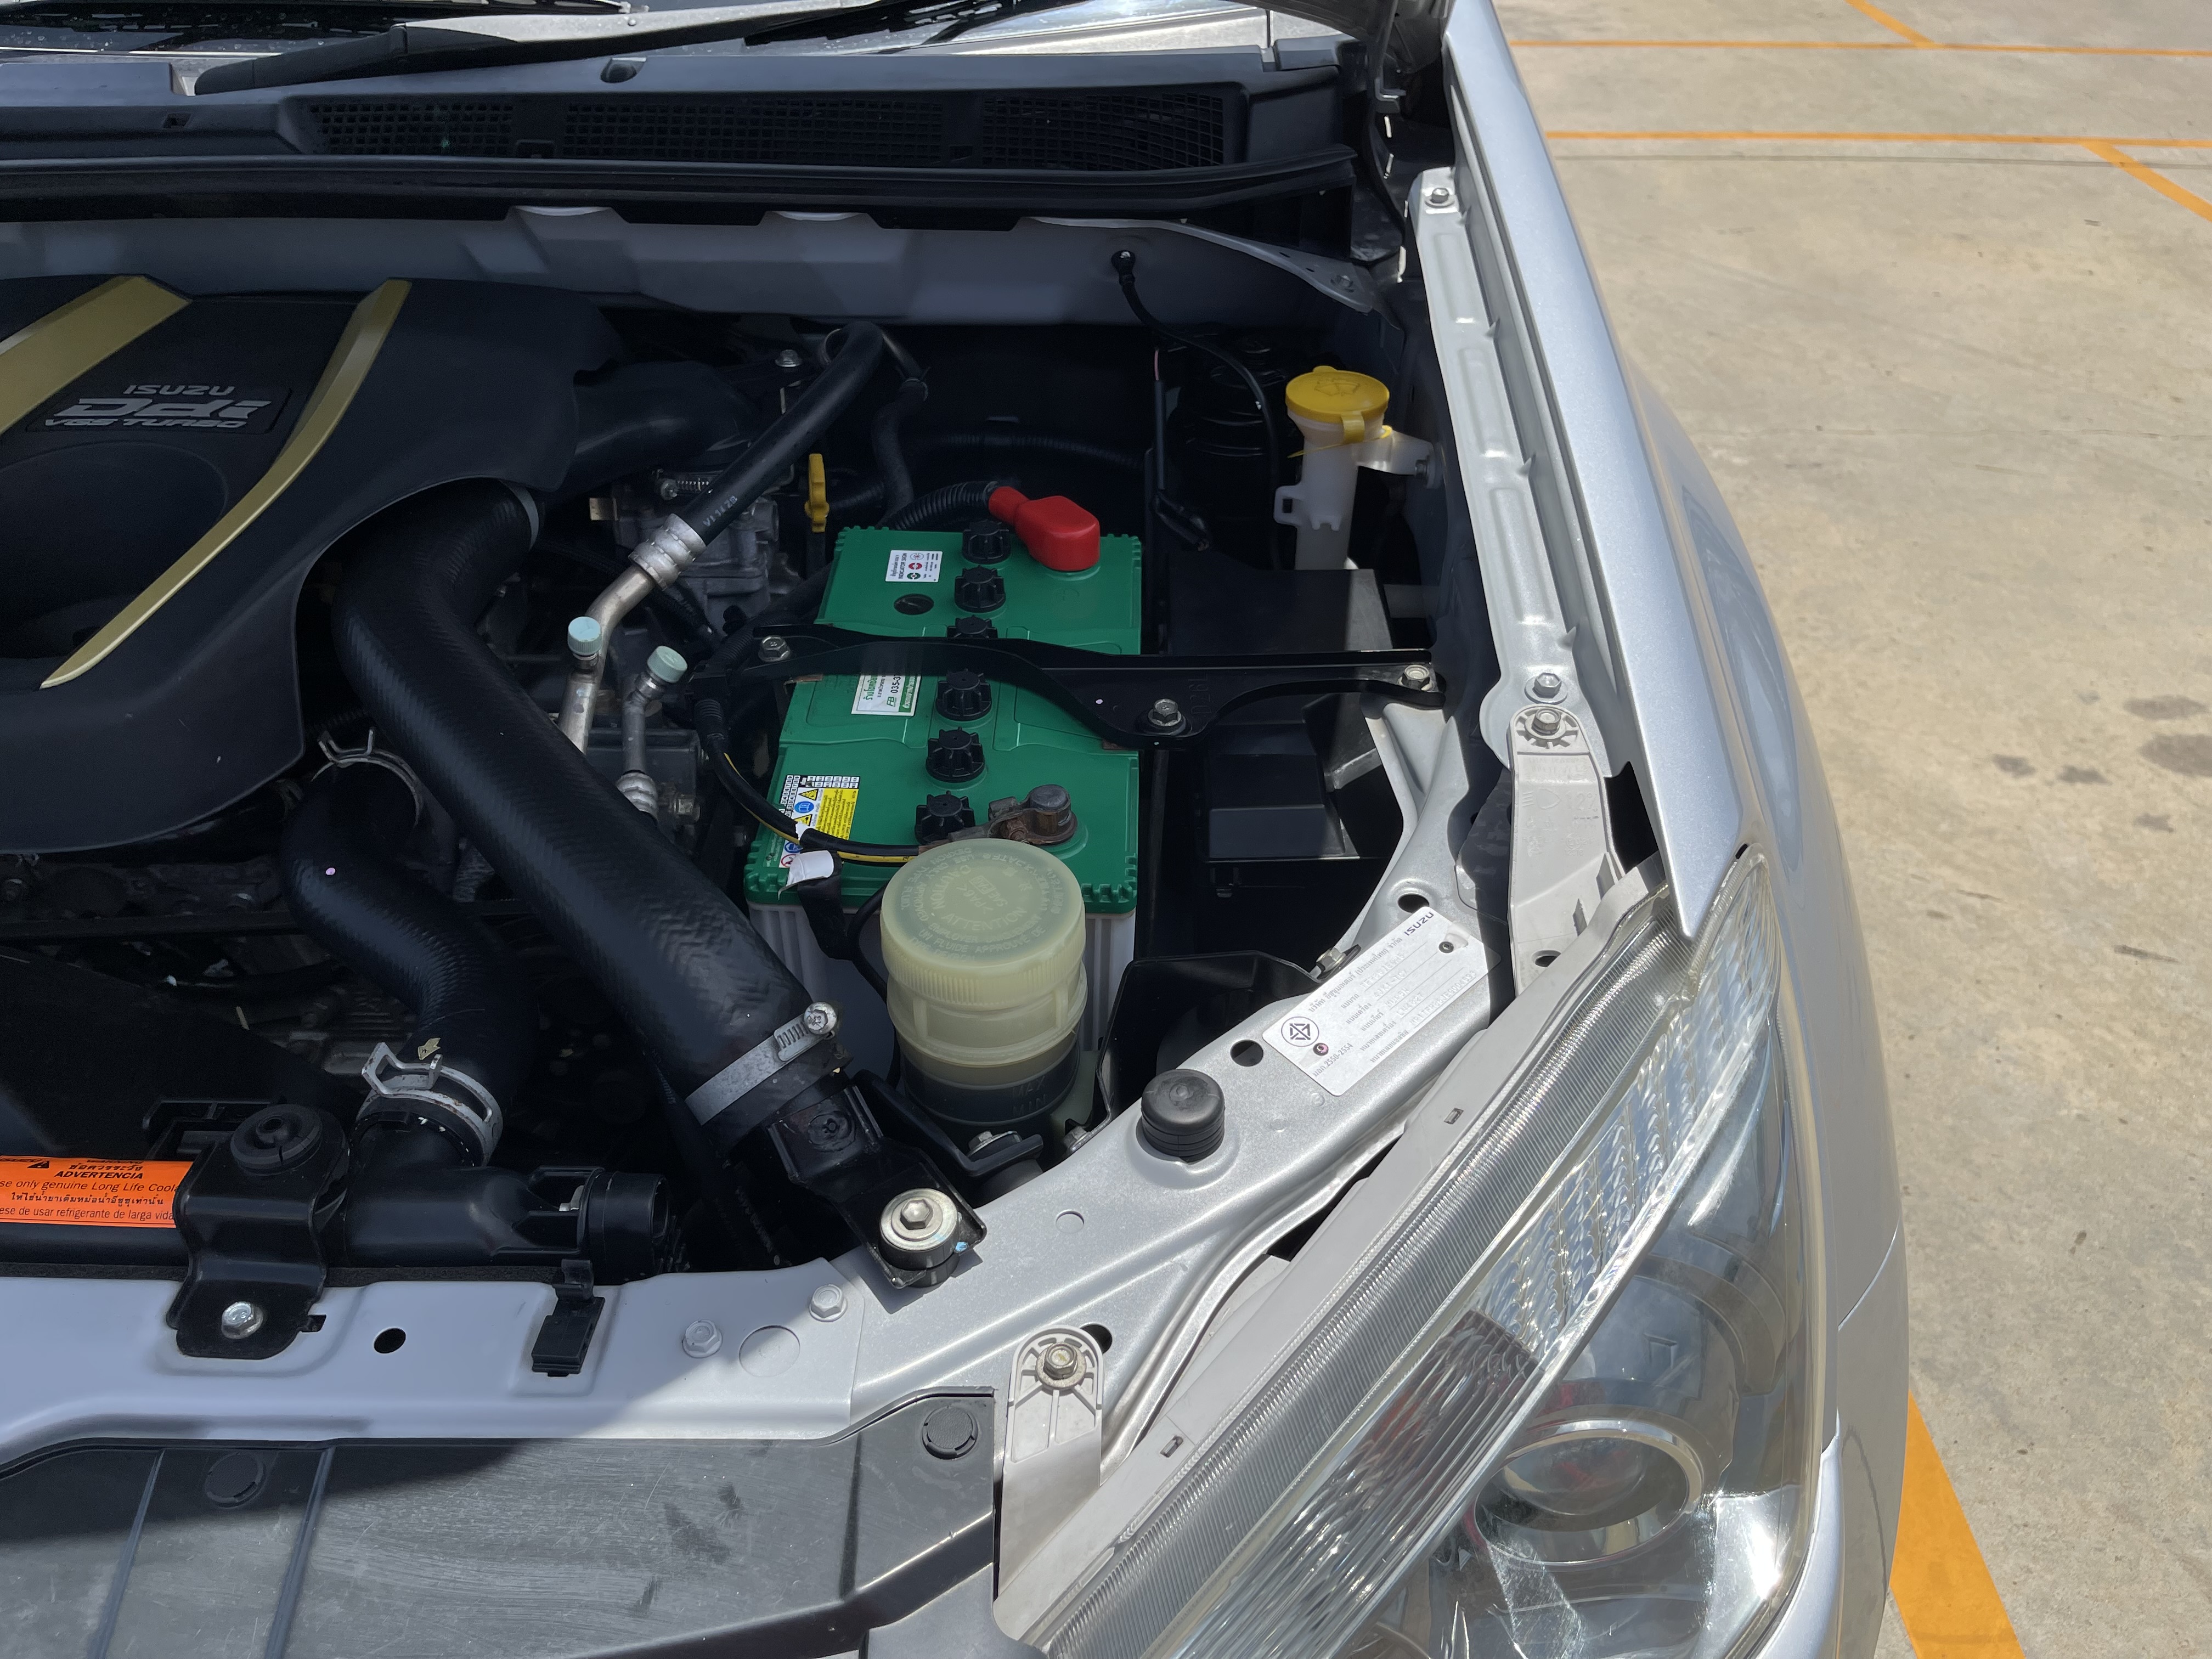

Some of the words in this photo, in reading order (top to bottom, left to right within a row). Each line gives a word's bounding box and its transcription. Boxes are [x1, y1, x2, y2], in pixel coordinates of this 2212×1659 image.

[122, 385, 236, 396] ISUZU
[122, 419, 248, 428] TURBO
[907, 866, 930, 883] TYPE
[925, 862, 949, 879] ONLY
[930, 865, 971, 910] CAUTION
[913, 881, 929, 921] APPROVED
[940, 906, 1027, 931] ATTENTION
[1404, 912, 1434, 935] ISUZU
[918, 929, 933, 941] UN
[934, 938, 969, 953] FLUIDE
[1031, 926, 1046, 938] DE
[929, 922, 978, 943] EMPLOYER
[1013, 1075, 1045, 1098] MAX
[1013, 1093, 1046, 1118] MIN
[54, 1171, 143, 1179] ADVERTENCIA
[16, 1180, 40, 1190] only
[41, 1181, 88, 1190] genuine
[92, 1182, 120, 1193] Long
[123, 1183, 144, 1192] Life
[19, 1207, 30, 1216] de
[56, 1207, 110, 1220] refrigerante
[113, 1209, 125, 1218] de
[128, 1210, 152, 1221] larga
[155, 1211, 173, 1220] vida
